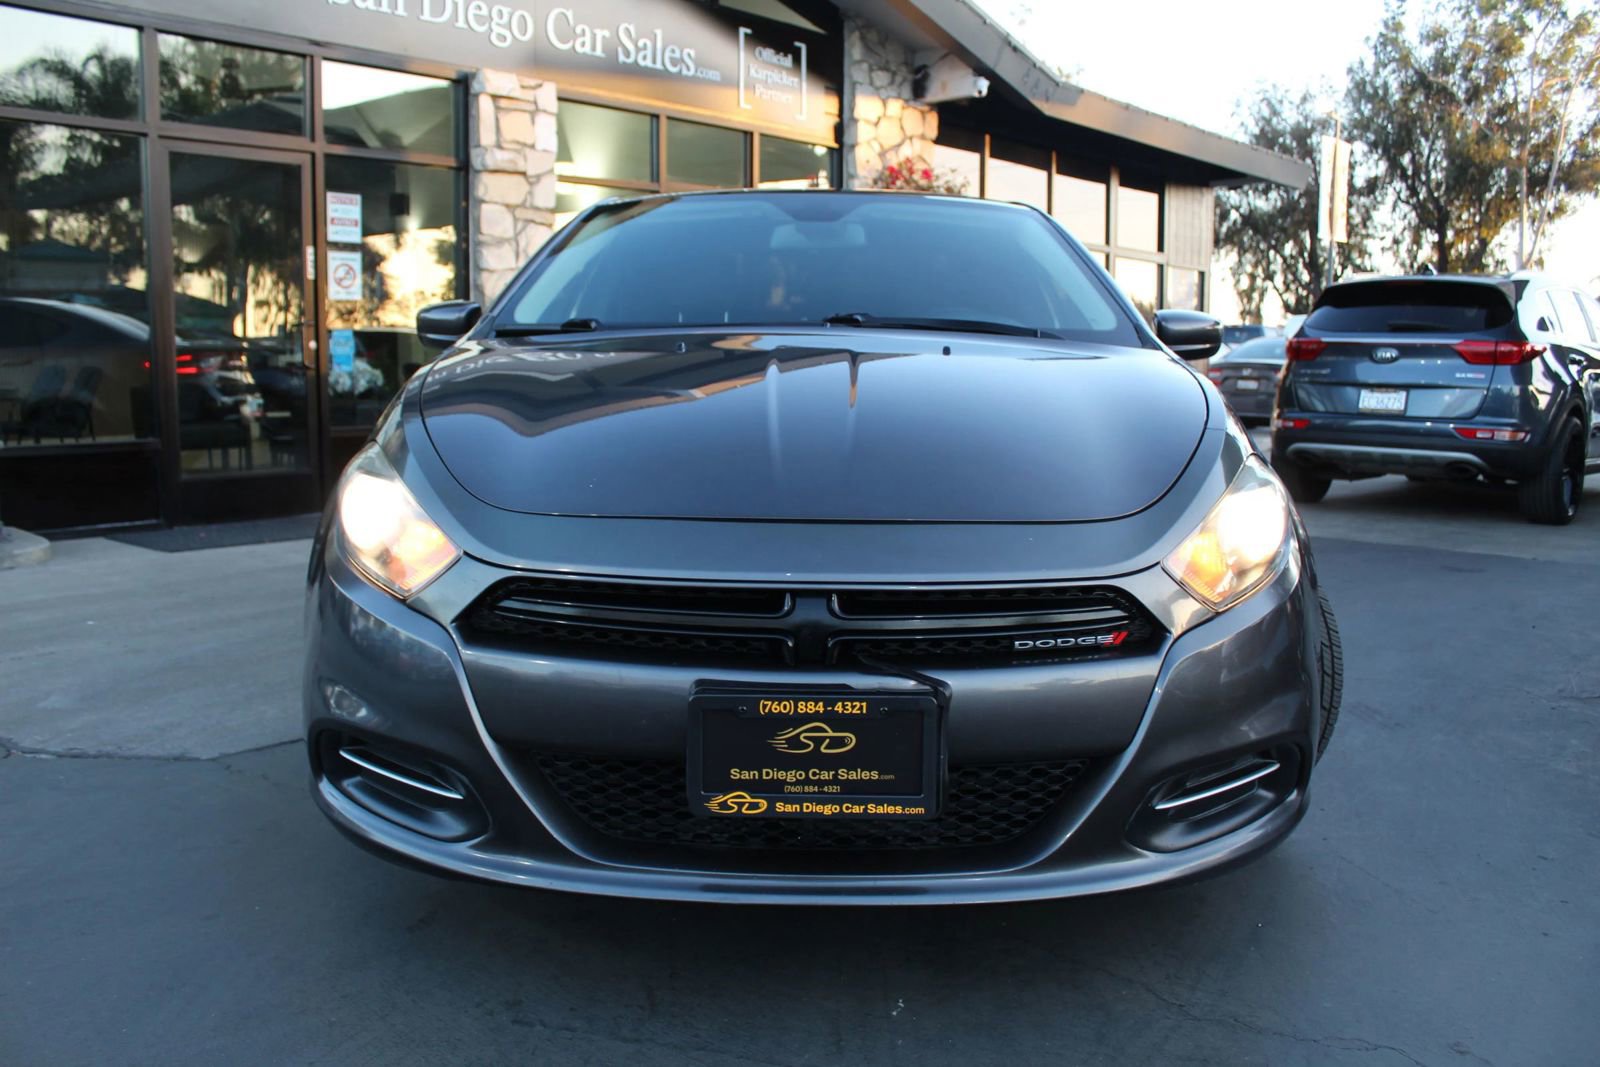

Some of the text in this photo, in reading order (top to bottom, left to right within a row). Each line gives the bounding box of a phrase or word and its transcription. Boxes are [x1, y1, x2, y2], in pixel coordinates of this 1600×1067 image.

[419, 0, 721, 82] Diego Car Sales.com
[754, 46, 793, 68] Official
[754, 83, 793, 105] Partner
[1014, 634, 1114, 650] DODGE
[759, 699, 795, 716] (760)
[730, 768, 895, 783] San Diego Car Sales.com
[784, 785, 803, 794] (760)
[775, 802, 925, 815] San Diego Car Sales.com
